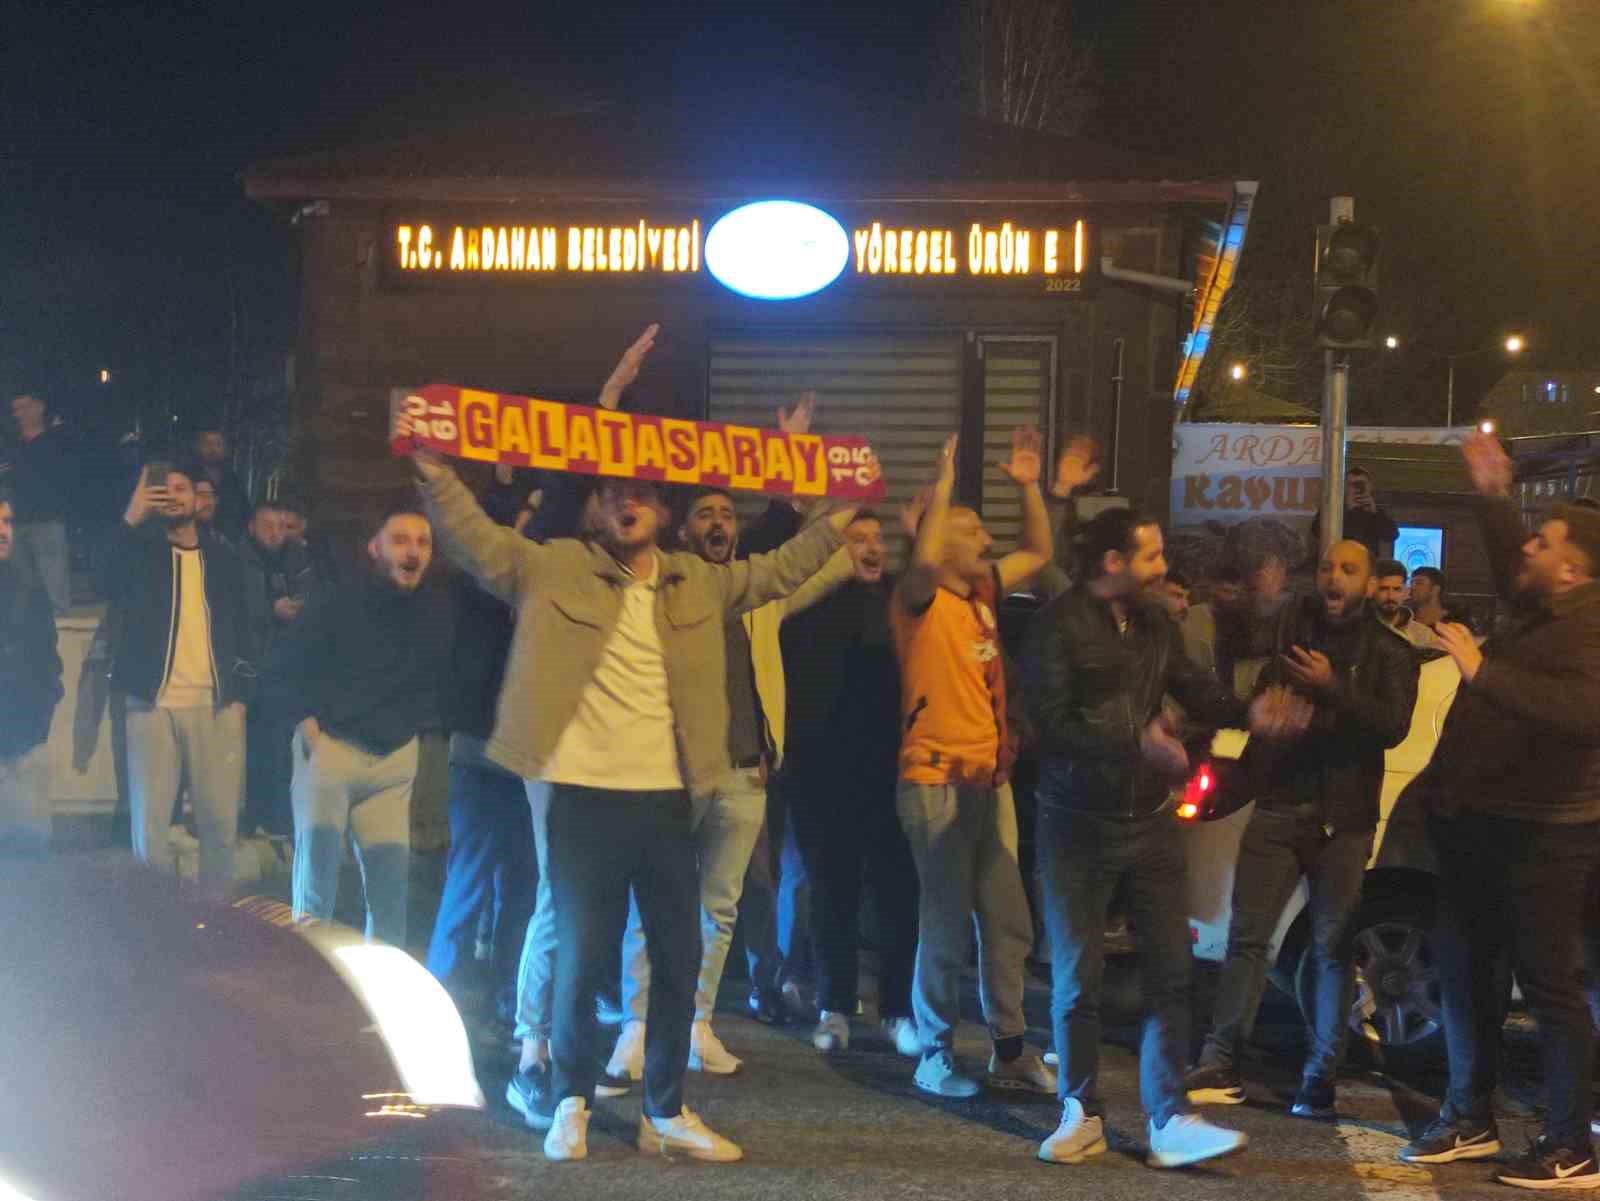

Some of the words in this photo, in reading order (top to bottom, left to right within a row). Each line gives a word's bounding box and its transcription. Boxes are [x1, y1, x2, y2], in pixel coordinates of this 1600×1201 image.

[398, 225, 442, 269] T.C.
[450, 226, 557, 270] ARDAHAN
[567, 219, 699, 271] BELEDİYESİ
[854, 222, 957, 274] YÖRESEL
[1045, 279, 1081, 291] 2022
[464, 401, 821, 483] GALATASARAY
